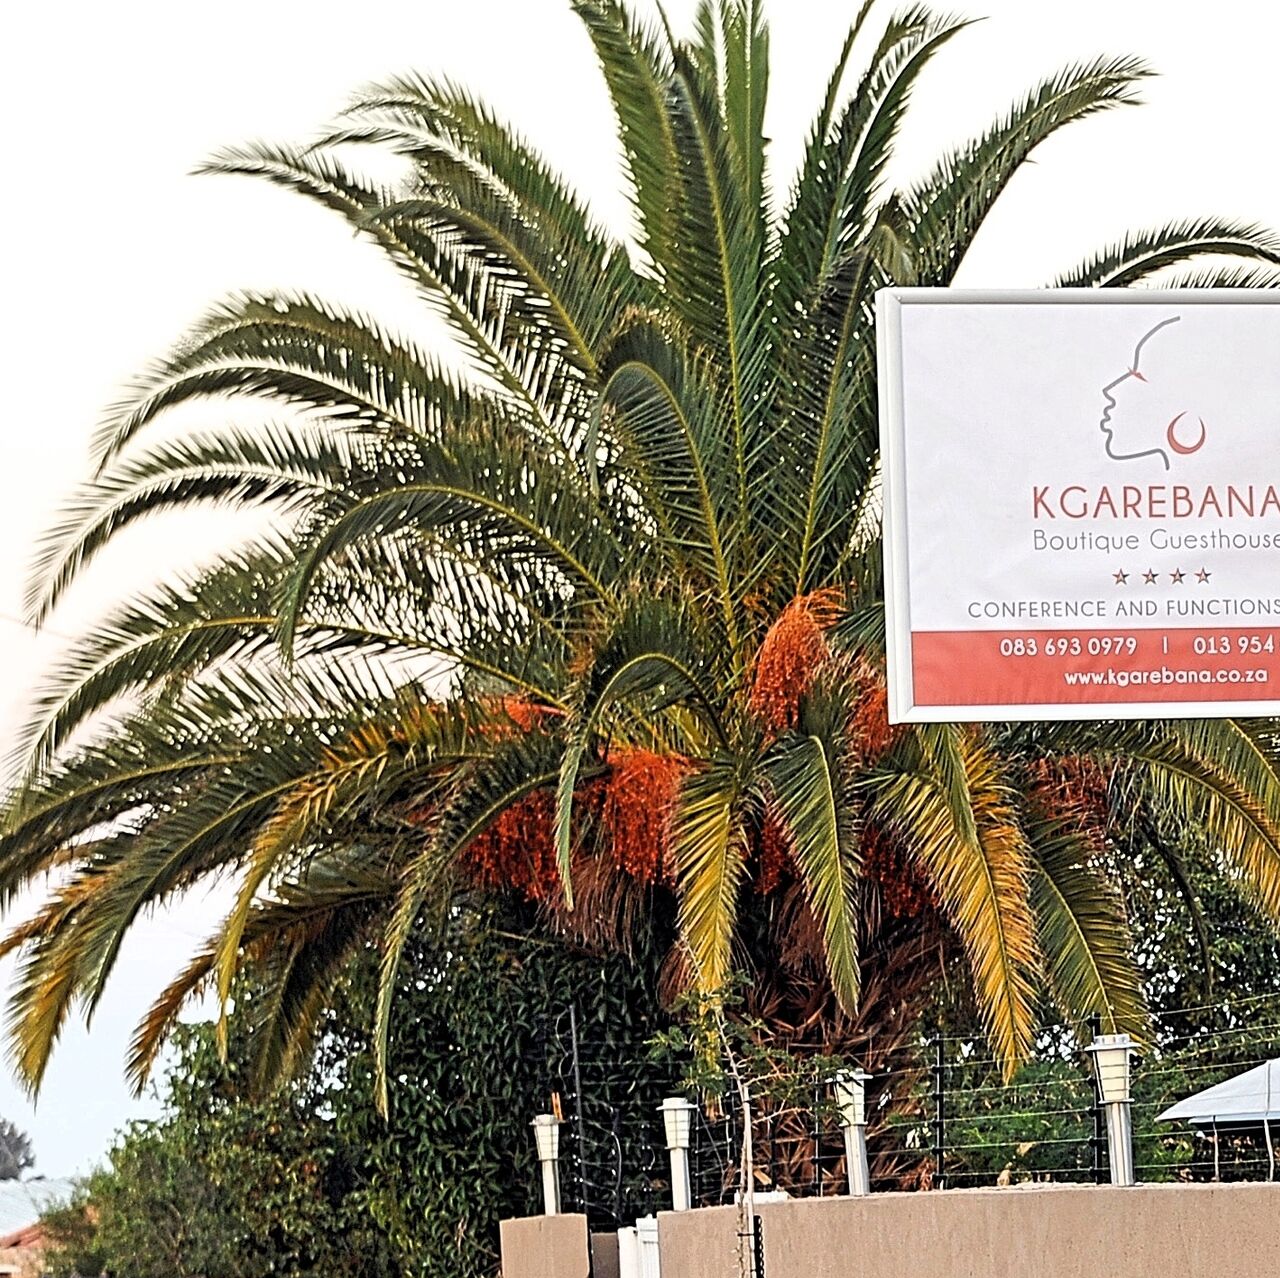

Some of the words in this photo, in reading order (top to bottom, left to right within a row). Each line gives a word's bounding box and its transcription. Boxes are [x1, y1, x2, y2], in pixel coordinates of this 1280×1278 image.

[1033, 529, 1140, 554] Boutique
[967, 601, 1107, 618] CONFERENCE
[1115, 600, 1158, 617] AND
[1000, 638, 1038, 657] 083
[1044, 637, 1082, 656] 693
[1087, 636, 1138, 656] 0979
[1193, 636, 1231, 655] 013
[1237, 634, 1275, 654] 954
[1064, 665, 1268, 687] www.kgarebana.co.za
